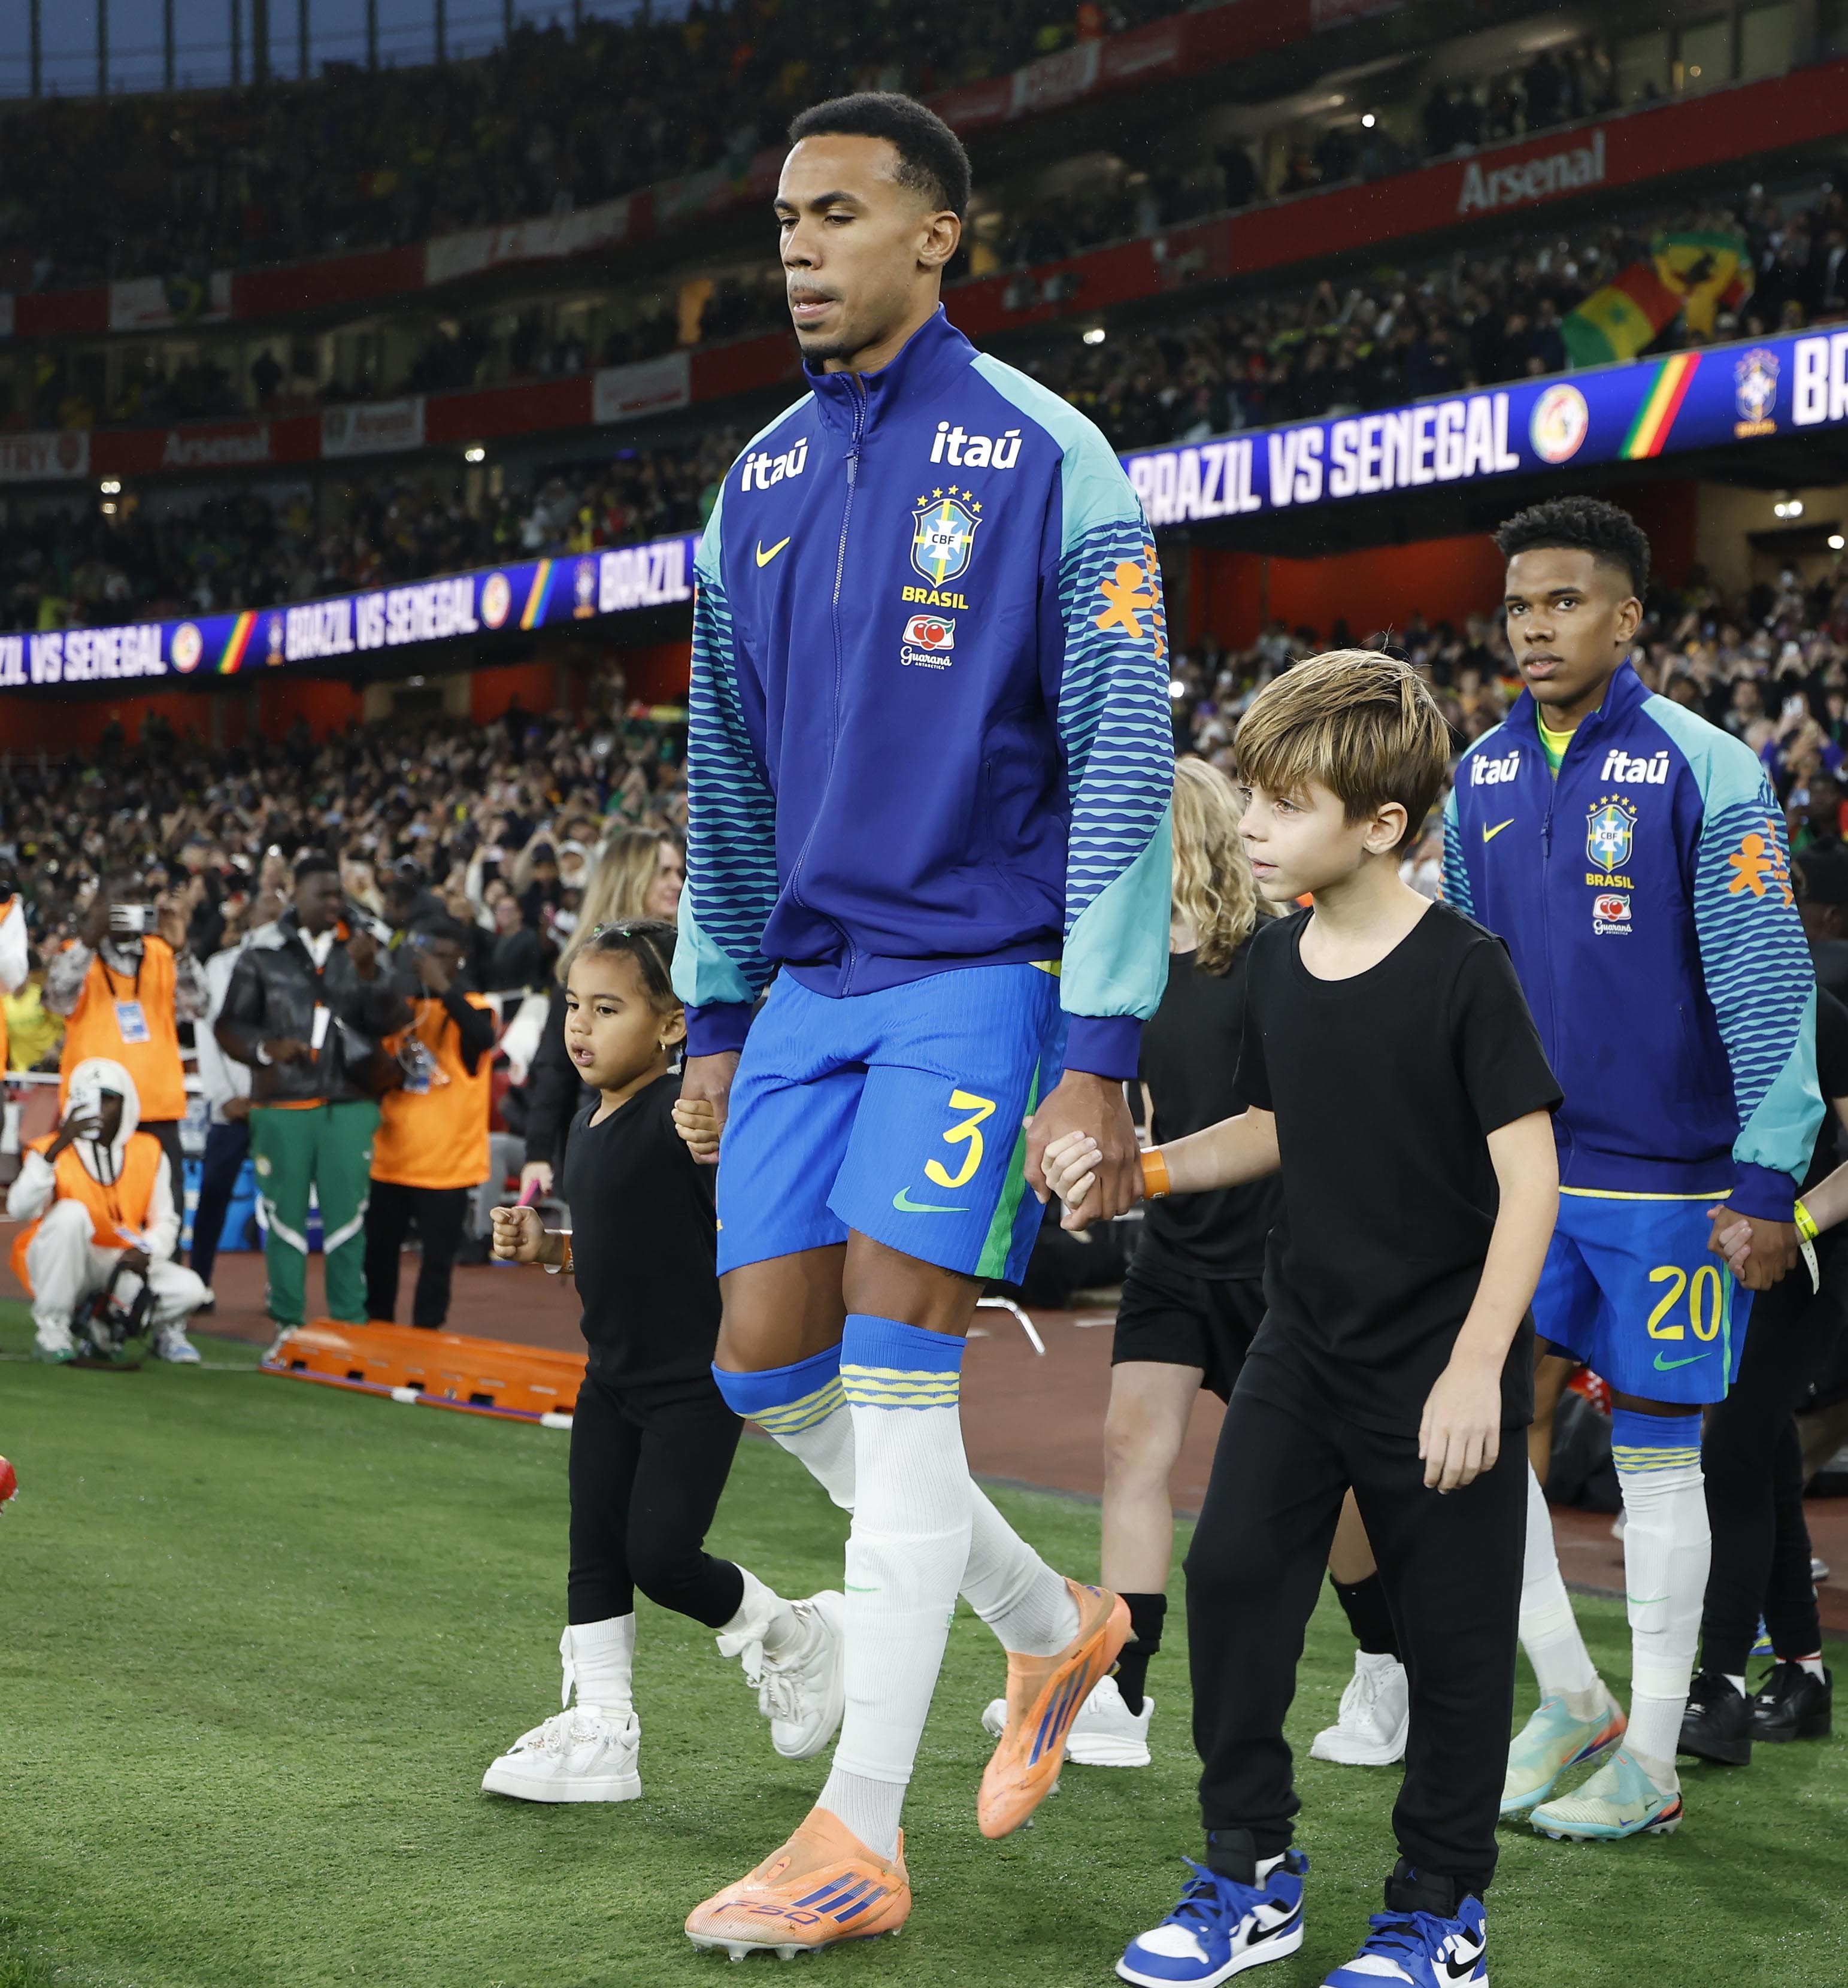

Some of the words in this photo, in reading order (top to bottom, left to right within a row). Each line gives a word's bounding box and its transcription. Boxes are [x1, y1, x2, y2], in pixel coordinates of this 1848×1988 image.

[1457, 129, 1606, 214] Arsenal
[160, 426, 269, 466] Arsenal
[929, 421, 1022, 469] itaú
[1267, 426, 1324, 507] VS
[1329, 391, 1520, 498] SENEGAL
[741, 437, 808, 492] itaú
[932, 534, 955, 545] CBF
[386, 576, 479, 646] SENEGAL
[901, 586, 969, 610] BRASIL
[30, 632, 63, 684] VS
[64, 623, 168, 681] SENEGAL
[901, 646, 952, 666] Guaraná
[914, 662, 945, 670] ANTARCTICA
[1470, 750, 1520, 787] itaú
[1601, 749, 1670, 785] itaú
[1601, 832, 1617, 840] CBF
[1586, 873, 1635, 889] BRASIL
[1593, 919, 1633, 935] Guaraná
[924, 1089, 996, 1188] 3
[1647, 1265, 1722, 1341] 20
